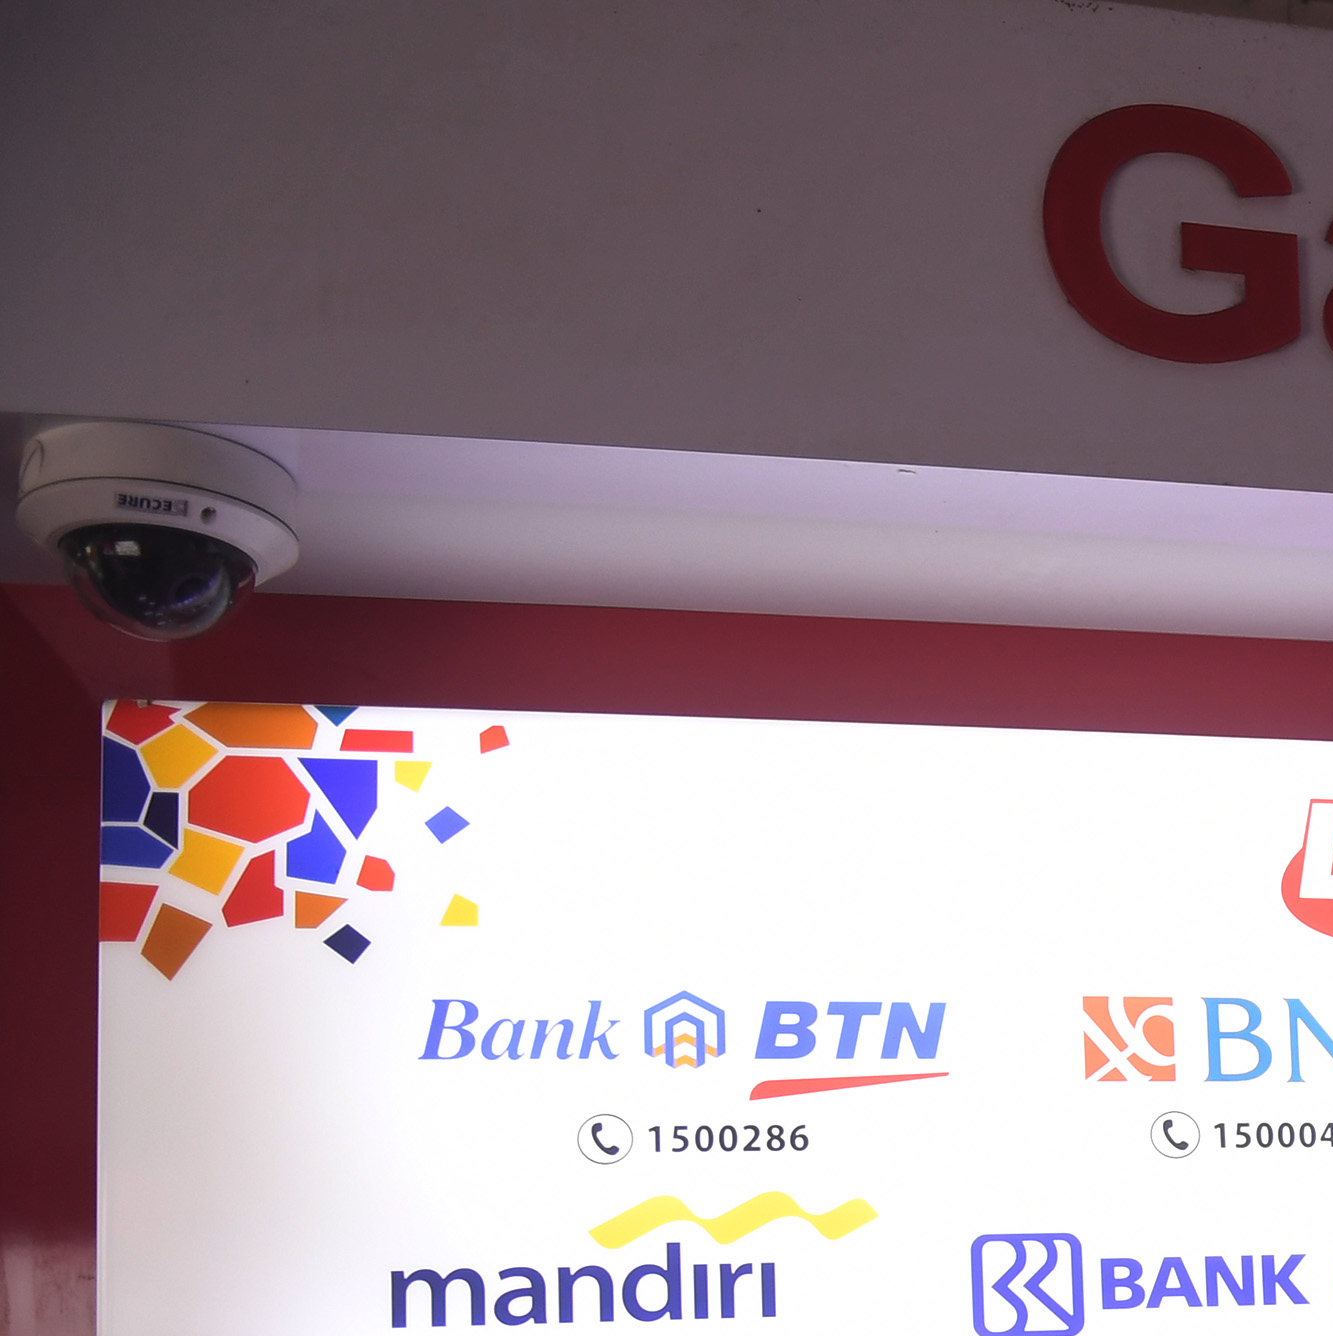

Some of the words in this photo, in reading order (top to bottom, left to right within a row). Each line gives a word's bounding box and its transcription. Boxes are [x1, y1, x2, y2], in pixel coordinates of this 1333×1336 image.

[418, 999, 621, 1060] Bank
[754, 1000, 947, 1060] BTN
[647, 1124, 810, 1152] 1500286
[1100, 1253, 1310, 1310] BANK
